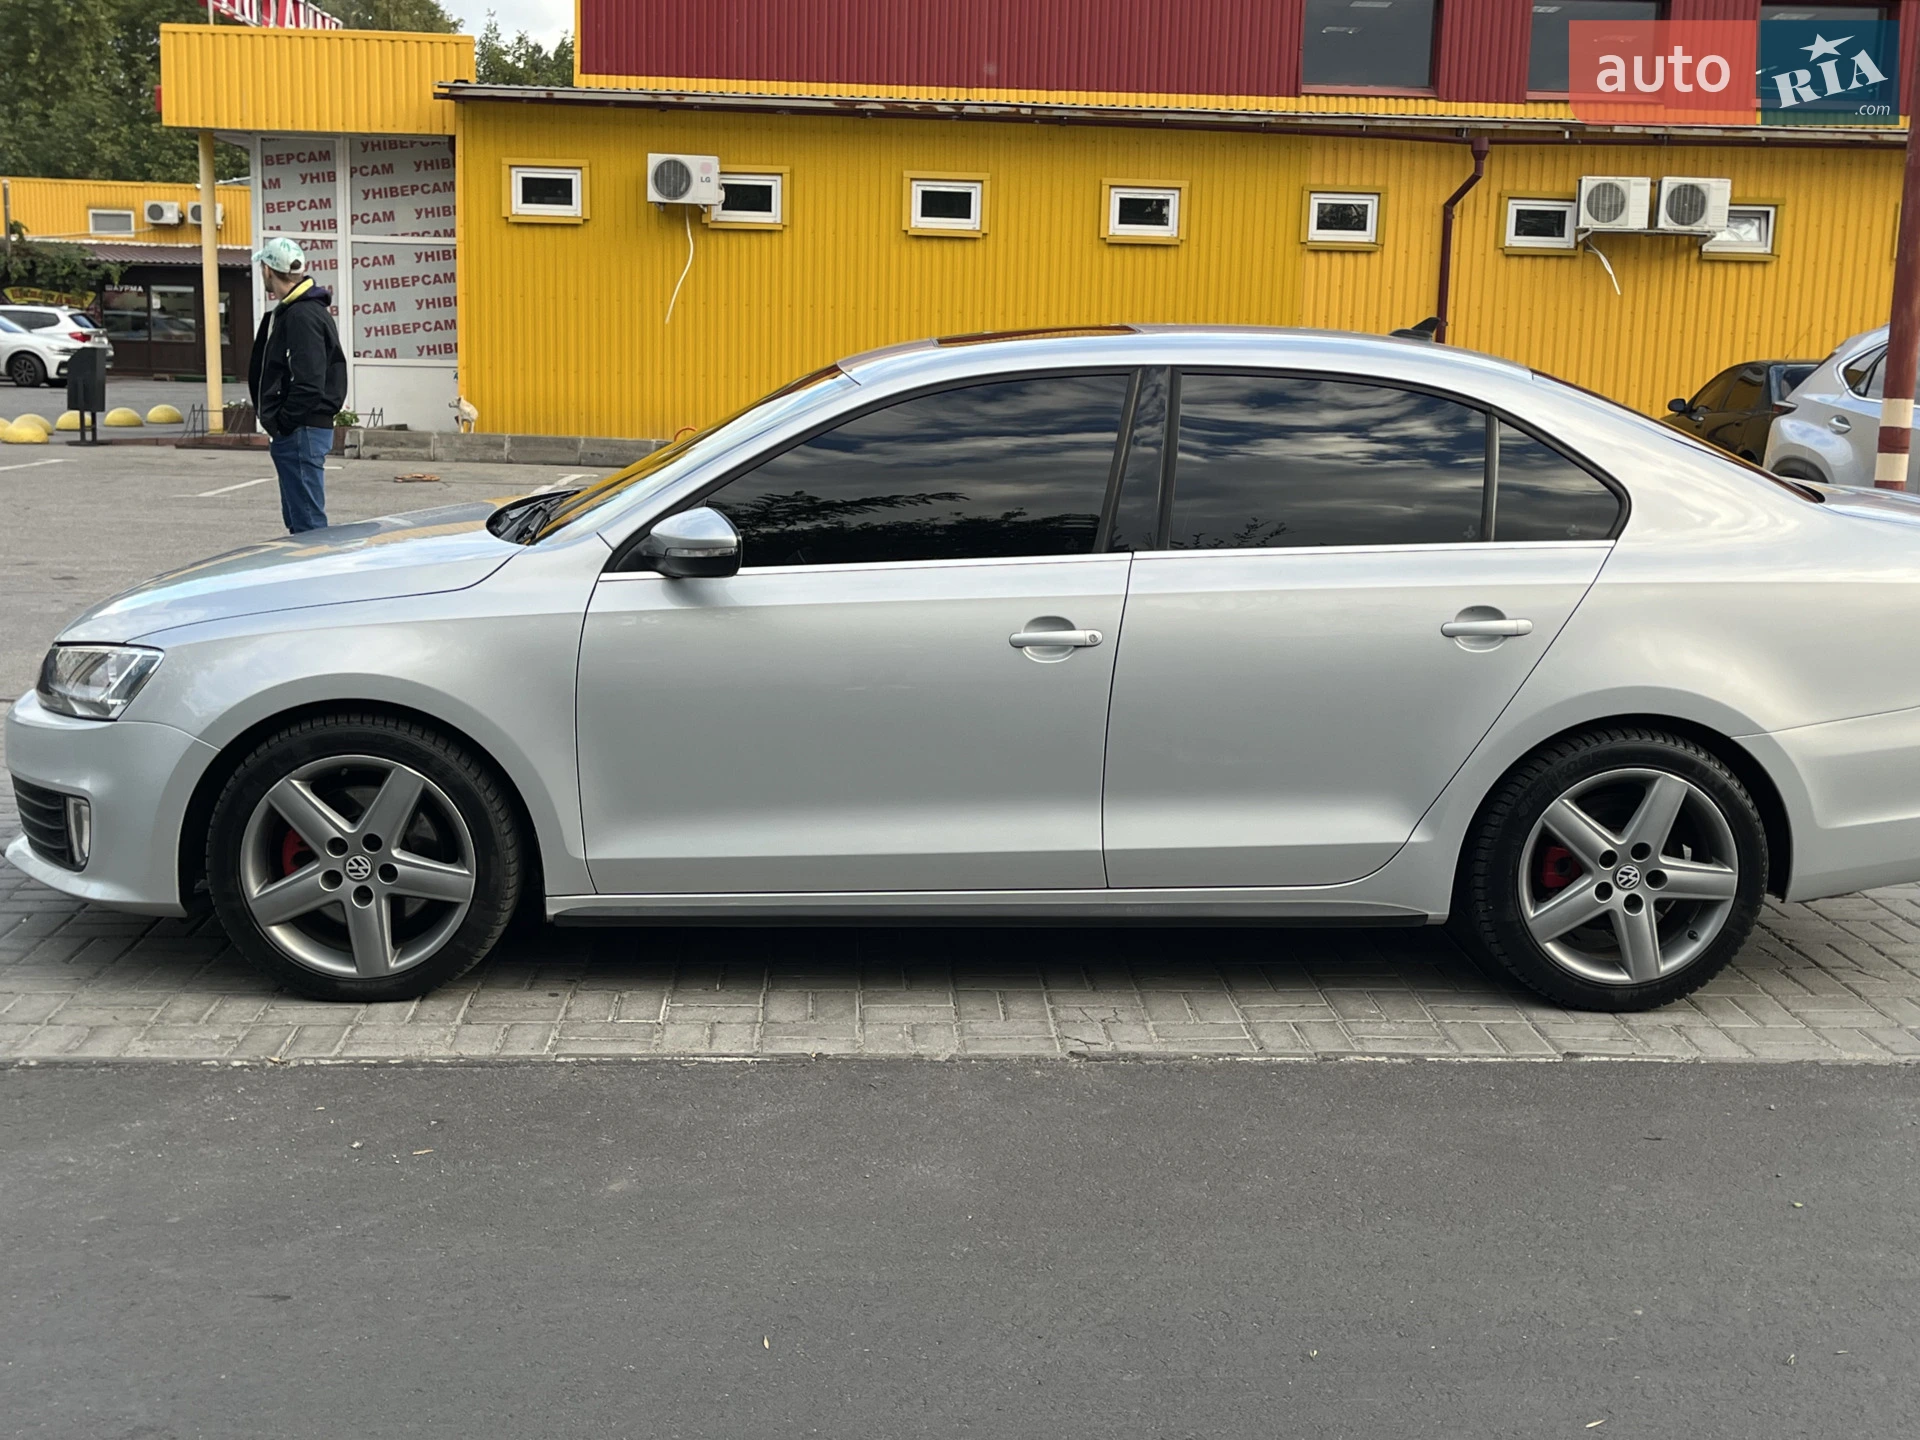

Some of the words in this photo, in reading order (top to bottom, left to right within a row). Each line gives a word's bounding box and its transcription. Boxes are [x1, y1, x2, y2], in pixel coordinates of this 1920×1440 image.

[361, 138, 448, 153] УНІВЕР
[300, 170, 336, 185] УНІВ
[362, 181, 456, 201] УНІВЕРСАМ
[300, 218, 337, 232] УНІВ
[363, 272, 456, 291] УНІВЕРСАМ
[364, 319, 457, 338] УНІВЕРСАМ
